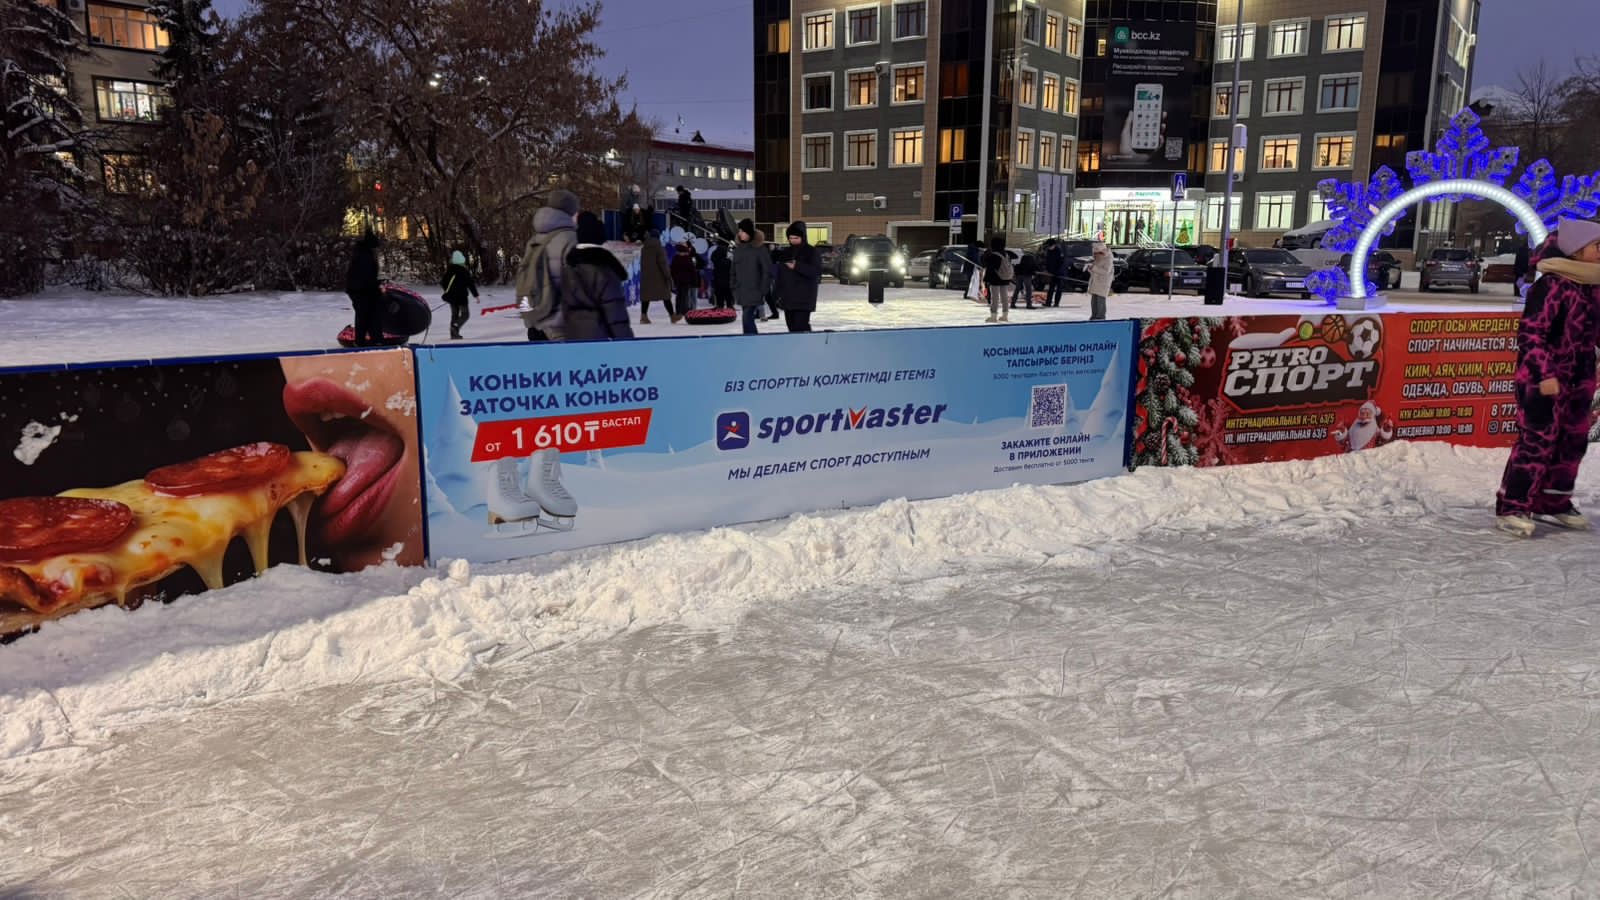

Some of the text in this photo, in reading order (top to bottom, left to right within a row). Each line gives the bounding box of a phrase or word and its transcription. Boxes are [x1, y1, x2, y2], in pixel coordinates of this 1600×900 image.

[1131, 30, 1160, 40] bcc.kz
[952, 206, 960, 216] P
[1410, 320, 1442, 332] СПОРТ
[1445, 319, 1466, 332] ОСЫ
[1469, 319, 1510, 333] ЖЕРДЕН
[984, 340, 1117, 358] ҚОСЫМША АРҚЫЛЫ ОНЛАЙН
[1408, 339, 1442, 352] СПОРТ
[1443, 338, 1506, 351] НАЧИНАЕТСЯ
[1006, 355, 1094, 368] ТАПСЫРЫС БЕРІҢІЗ
[1405, 364, 1432, 377] КИІМ,
[1435, 364, 1456, 377] АЯҚ
[1458, 363, 1484, 376] КИІМ,
[470, 364, 648, 392] КОНЬКИ ҚАЙРАУ
[724, 368, 936, 392] БІЗ СПОРТТЫ ҚОЛЖЕТІМДІ ЕТЕМІЗ
[1224, 361, 1375, 396] СПОРТ
[1402, 383, 1449, 398] ОДЕЖДА,
[1452, 382, 1486, 395] ОБУВЬ,
[460, 386, 659, 416] ЗАТОЧКА КОНЬКОВ
[1491, 404, 1498, 416] 8
[1226, 416, 1301, 429] ИНТЕРНАЦИОНАЛЬНАЯ
[1319, 413, 1334, 424] 63/5
[512, 427, 523, 449] 1
[602, 416, 641, 428] БАСТАП
[1236, 429, 1312, 442] ИНТЕРНАЦИОНАЛЬНАЯ
[1312, 428, 1328, 438] 63/5
[1397, 426, 1435, 437] ЕЖЕДНЕВНО
[1002, 432, 1090, 450] ЗАКАЖИТЕ ОНЛАЙН
[1010, 446, 1082, 461] В ПРИЛОЖЕНИИ
[728, 448, 930, 480] МЫ ДЕЛАЕМ СПОРТ ДОСТУПНЫМ
